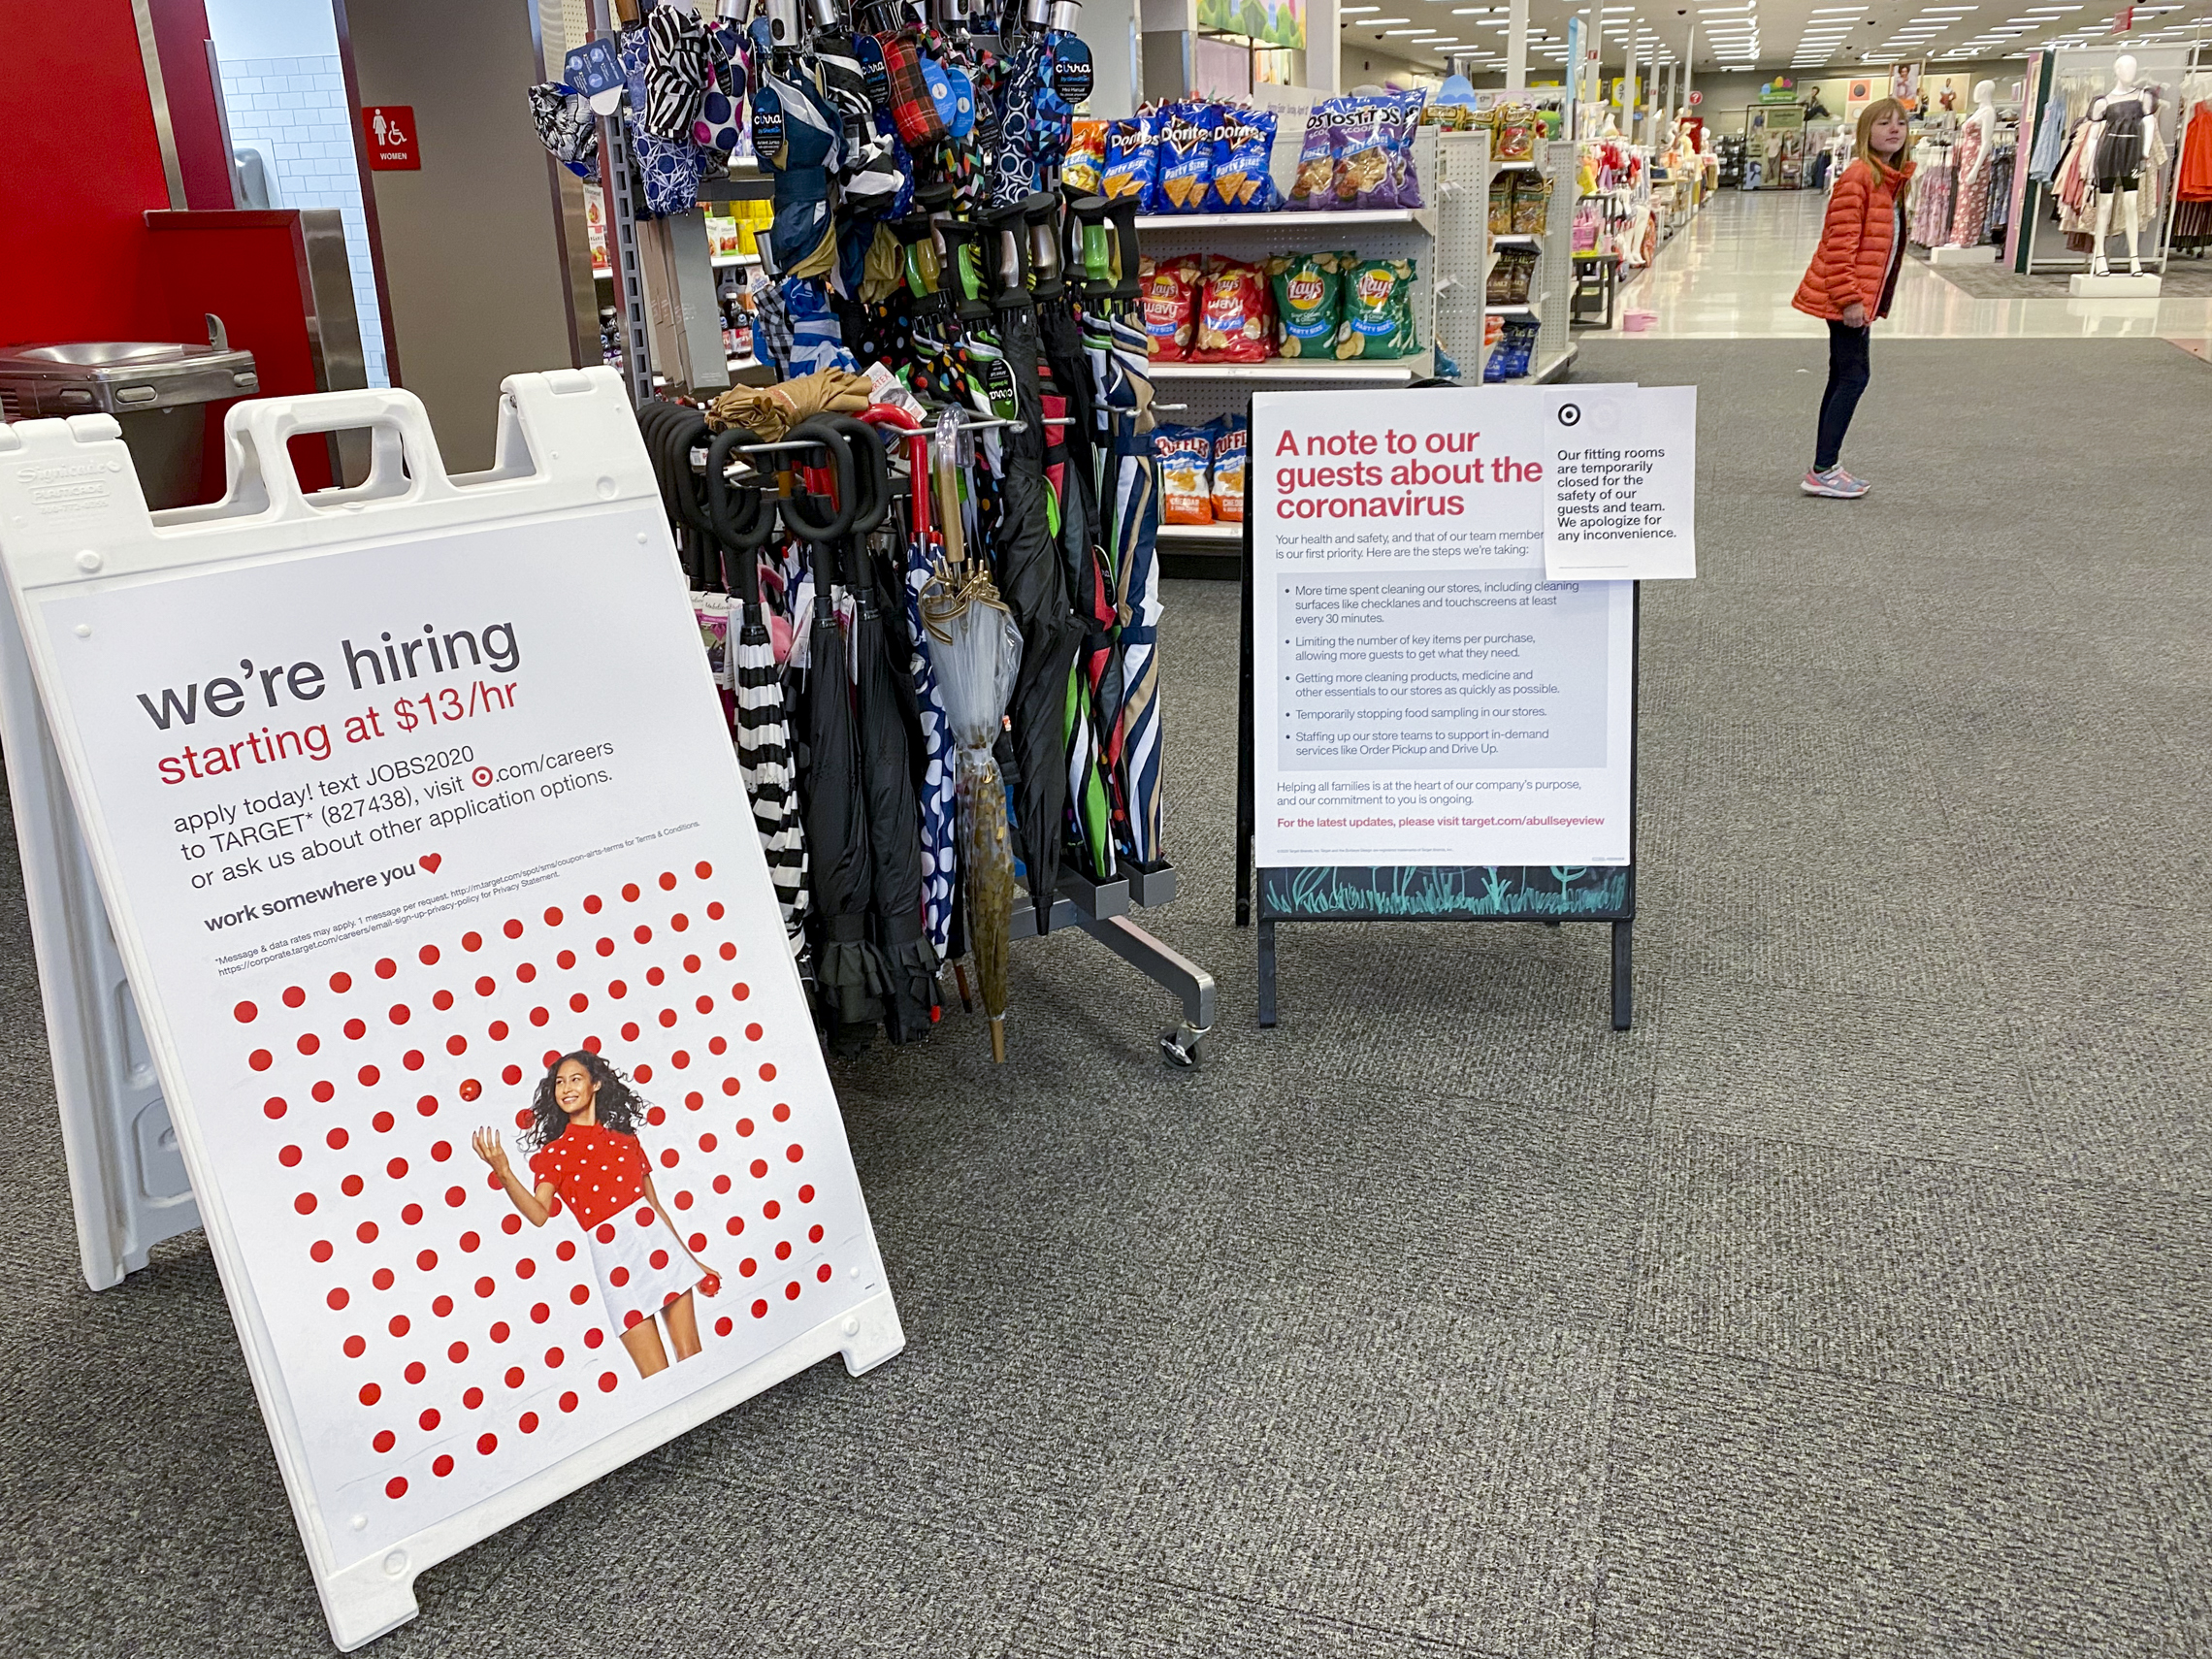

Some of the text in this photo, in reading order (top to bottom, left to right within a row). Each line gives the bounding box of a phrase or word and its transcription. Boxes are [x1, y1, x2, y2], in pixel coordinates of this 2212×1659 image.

[1056, 61, 1091, 74] cirra
[754, 113, 782, 125] cirra
[379, 152, 407, 161] WOMEN
[1275, 428, 1480, 457] A note to our
[1557, 447, 1666, 462] Our fitting rooms
[1276, 455, 1544, 496] guests about the
[1556, 460, 1654, 475] are temporarily
[1557, 473, 1644, 488] closed for the
[1557, 488, 1638, 503] safety of our
[1276, 495, 1465, 520] coronavirus
[1557, 501, 1666, 517] guests and team.
[1556, 514, 1663, 530] We apologize for
[1275, 529, 1545, 546] Your health and safety, and that of our team member
[1557, 527, 1677, 543] any inconvenience.
[1275, 543, 1530, 561] is our first priority. Here are the steps we're taking:
[1295, 580, 1579, 598] More time spent cleaning our stores, including cleaning
[1295, 595, 1557, 610] surfaces like checklanes and touchscreens at least
[1294, 612, 1384, 627] every 30 minutes.
[136, 621, 520, 731] we're hiring
[158, 680, 518, 785] starting at $13/hr
[174, 745, 474, 834] apply today! text JOBS2020
[179, 843, 206, 862] to
[321, 785, 420, 830] (827438),
[423, 775, 467, 799] visit
[495, 742, 614, 783] .com/careers
[191, 769, 613, 890] or ask us about other application options.
[1277, 815, 1606, 829] For the latest updates, please visit target.com/abullseyeview
[203, 863, 416, 932] work somewhere you
